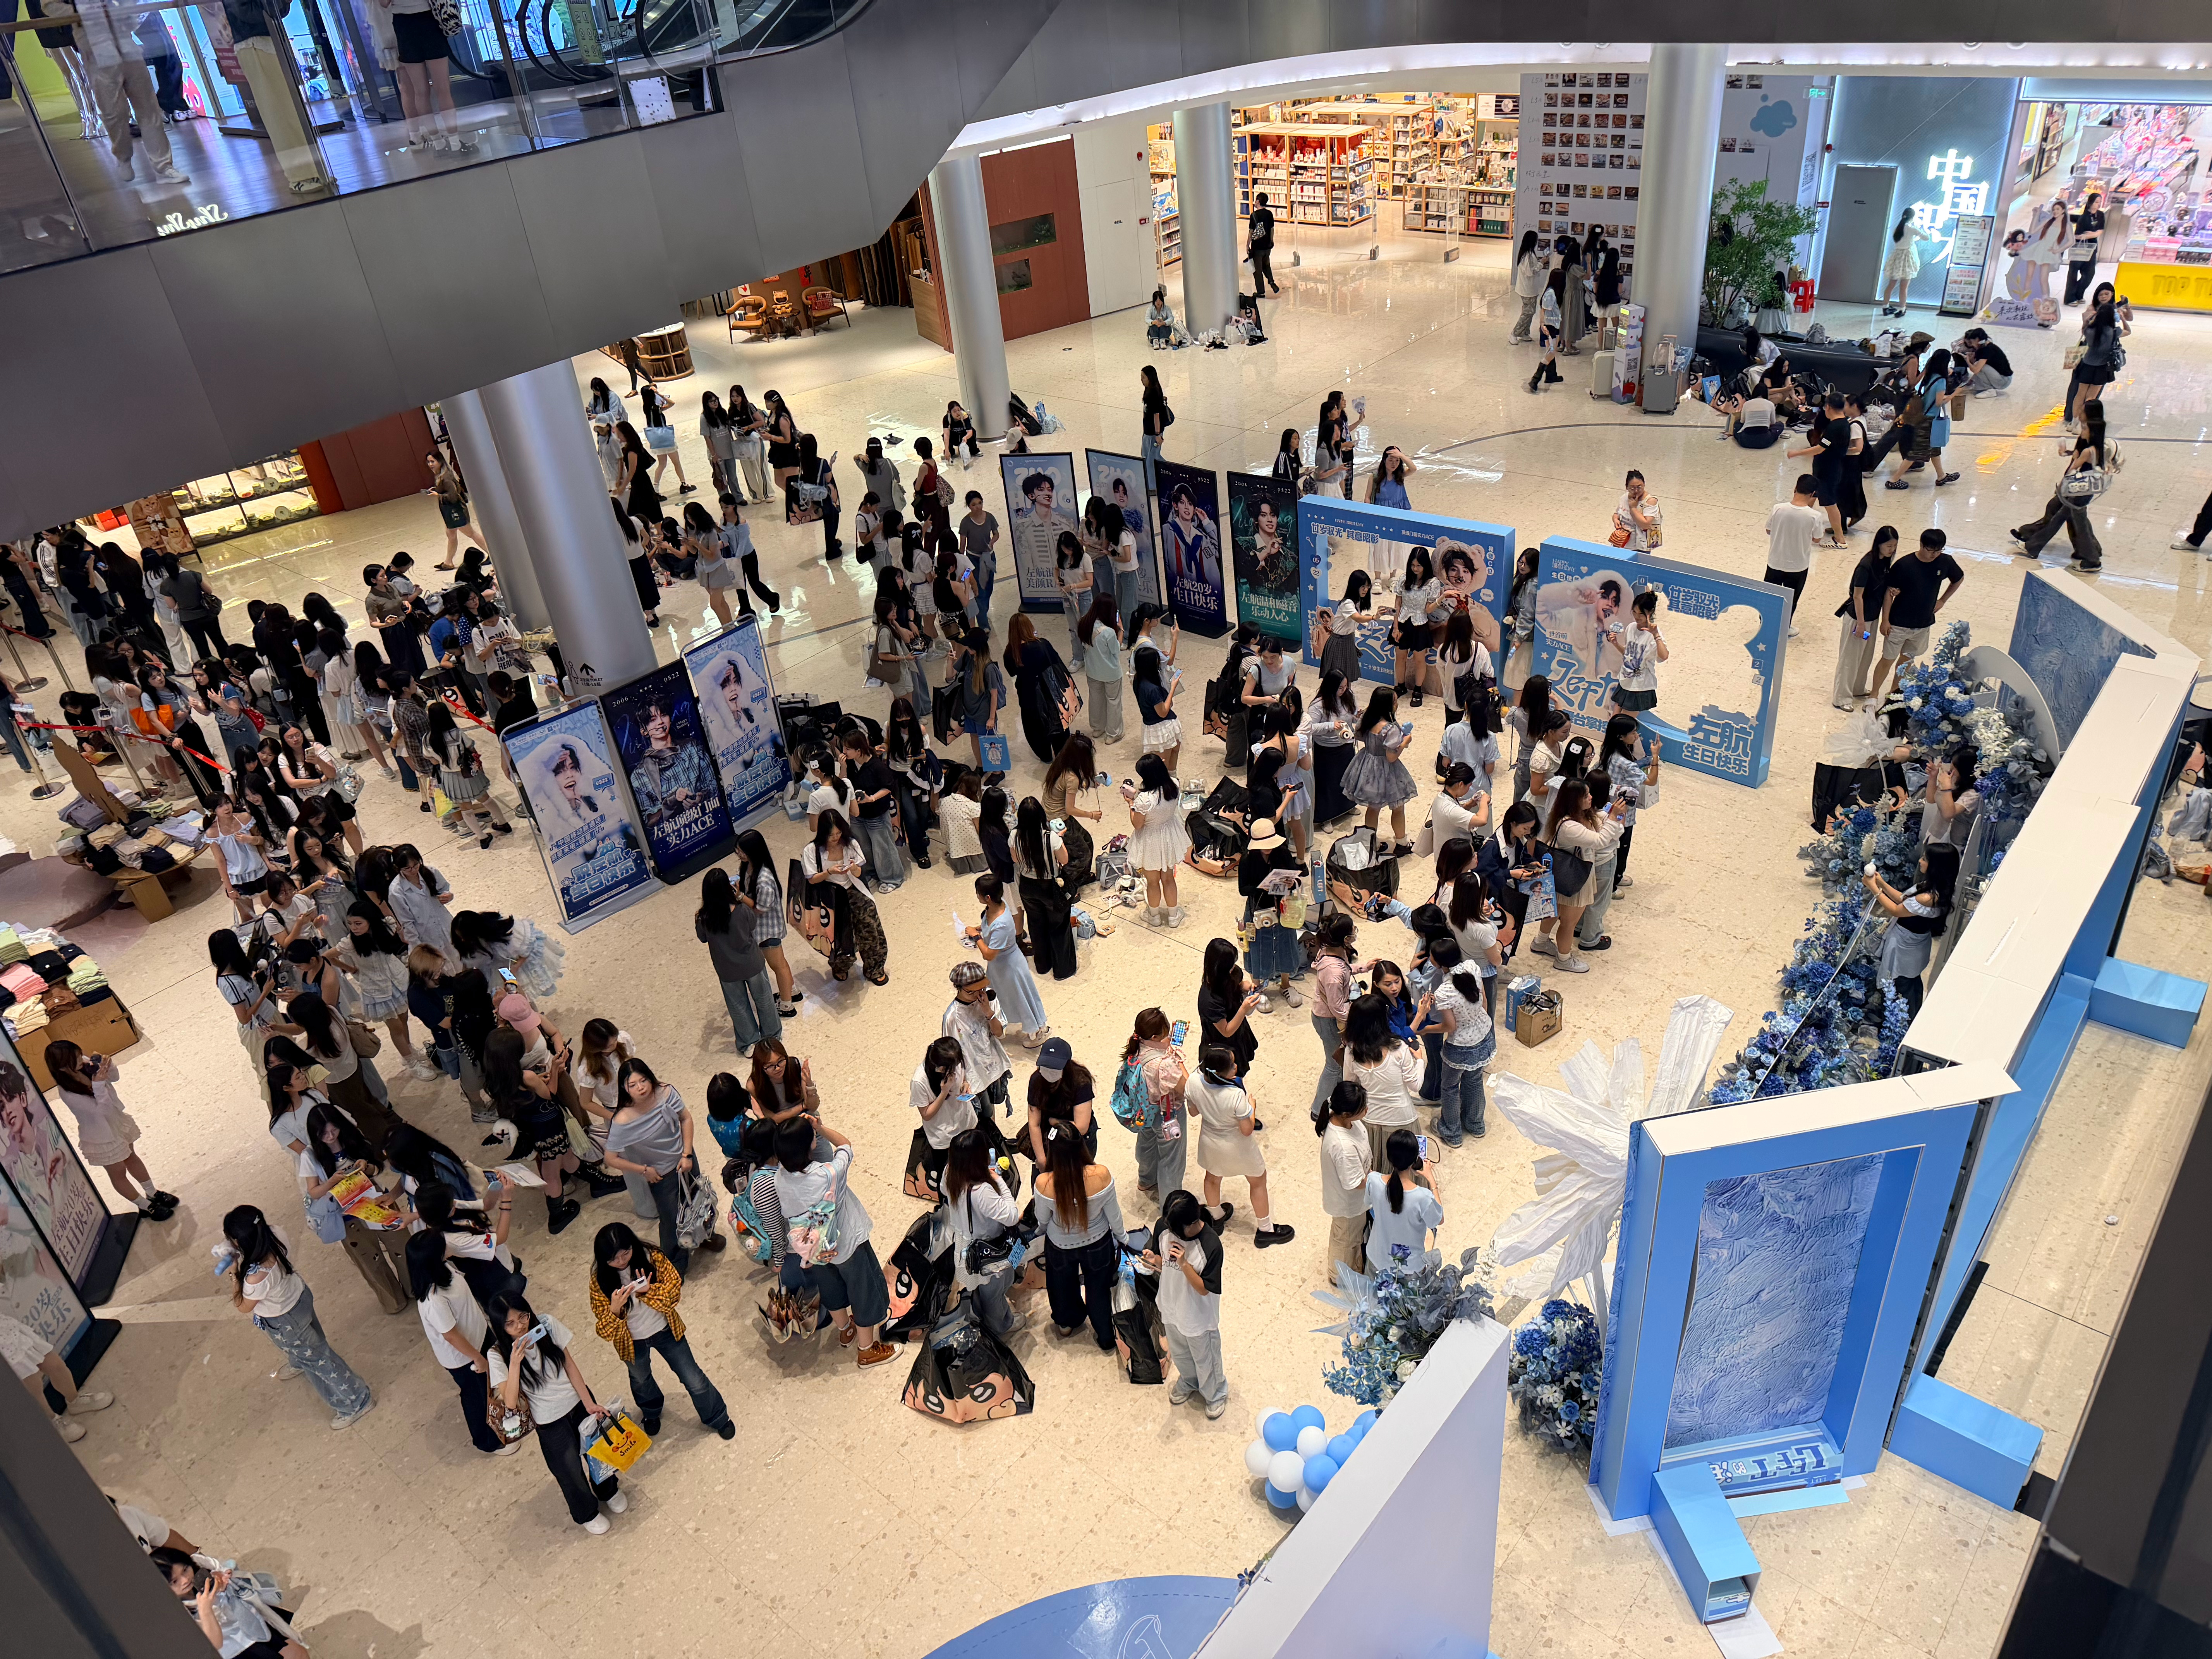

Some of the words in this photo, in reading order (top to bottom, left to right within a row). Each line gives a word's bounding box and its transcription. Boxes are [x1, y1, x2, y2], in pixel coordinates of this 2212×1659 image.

[2152, 275, 2191, 296] TOP
[1310, 522, 1343, 538] 廿岁驭光
[1346, 529, 1380, 544] 其意昭彰
[1173, 587, 1218, 610] 生日快乐
[1176, 576, 1212, 595] 左航20岁
[1668, 585, 1720, 606] 廿岁驭光
[1251, 606, 1289, 622] 乐动人心
[1546, 639, 1570, 652] 实力ACE
[664, 672, 680, 684] 0522
[612, 696, 629, 708] 2006
[1687, 713, 1753, 759] 左航
[733, 756, 774, 789] 祝左航
[1682, 743, 1749, 776] 生日快乐
[732, 766, 783, 807] 生日快乐
[557, 815, 602, 846] 中国移动新通话
[666, 813, 714, 848] 实力ACE
[572, 848, 623, 883] 祝左航
[570, 858, 635, 902] 生日快乐
[58, 1196, 94, 1267] 生日快乐
[620, 1440, 637, 1456] Smile
[1749, 1444, 1827, 1480] LEFT
